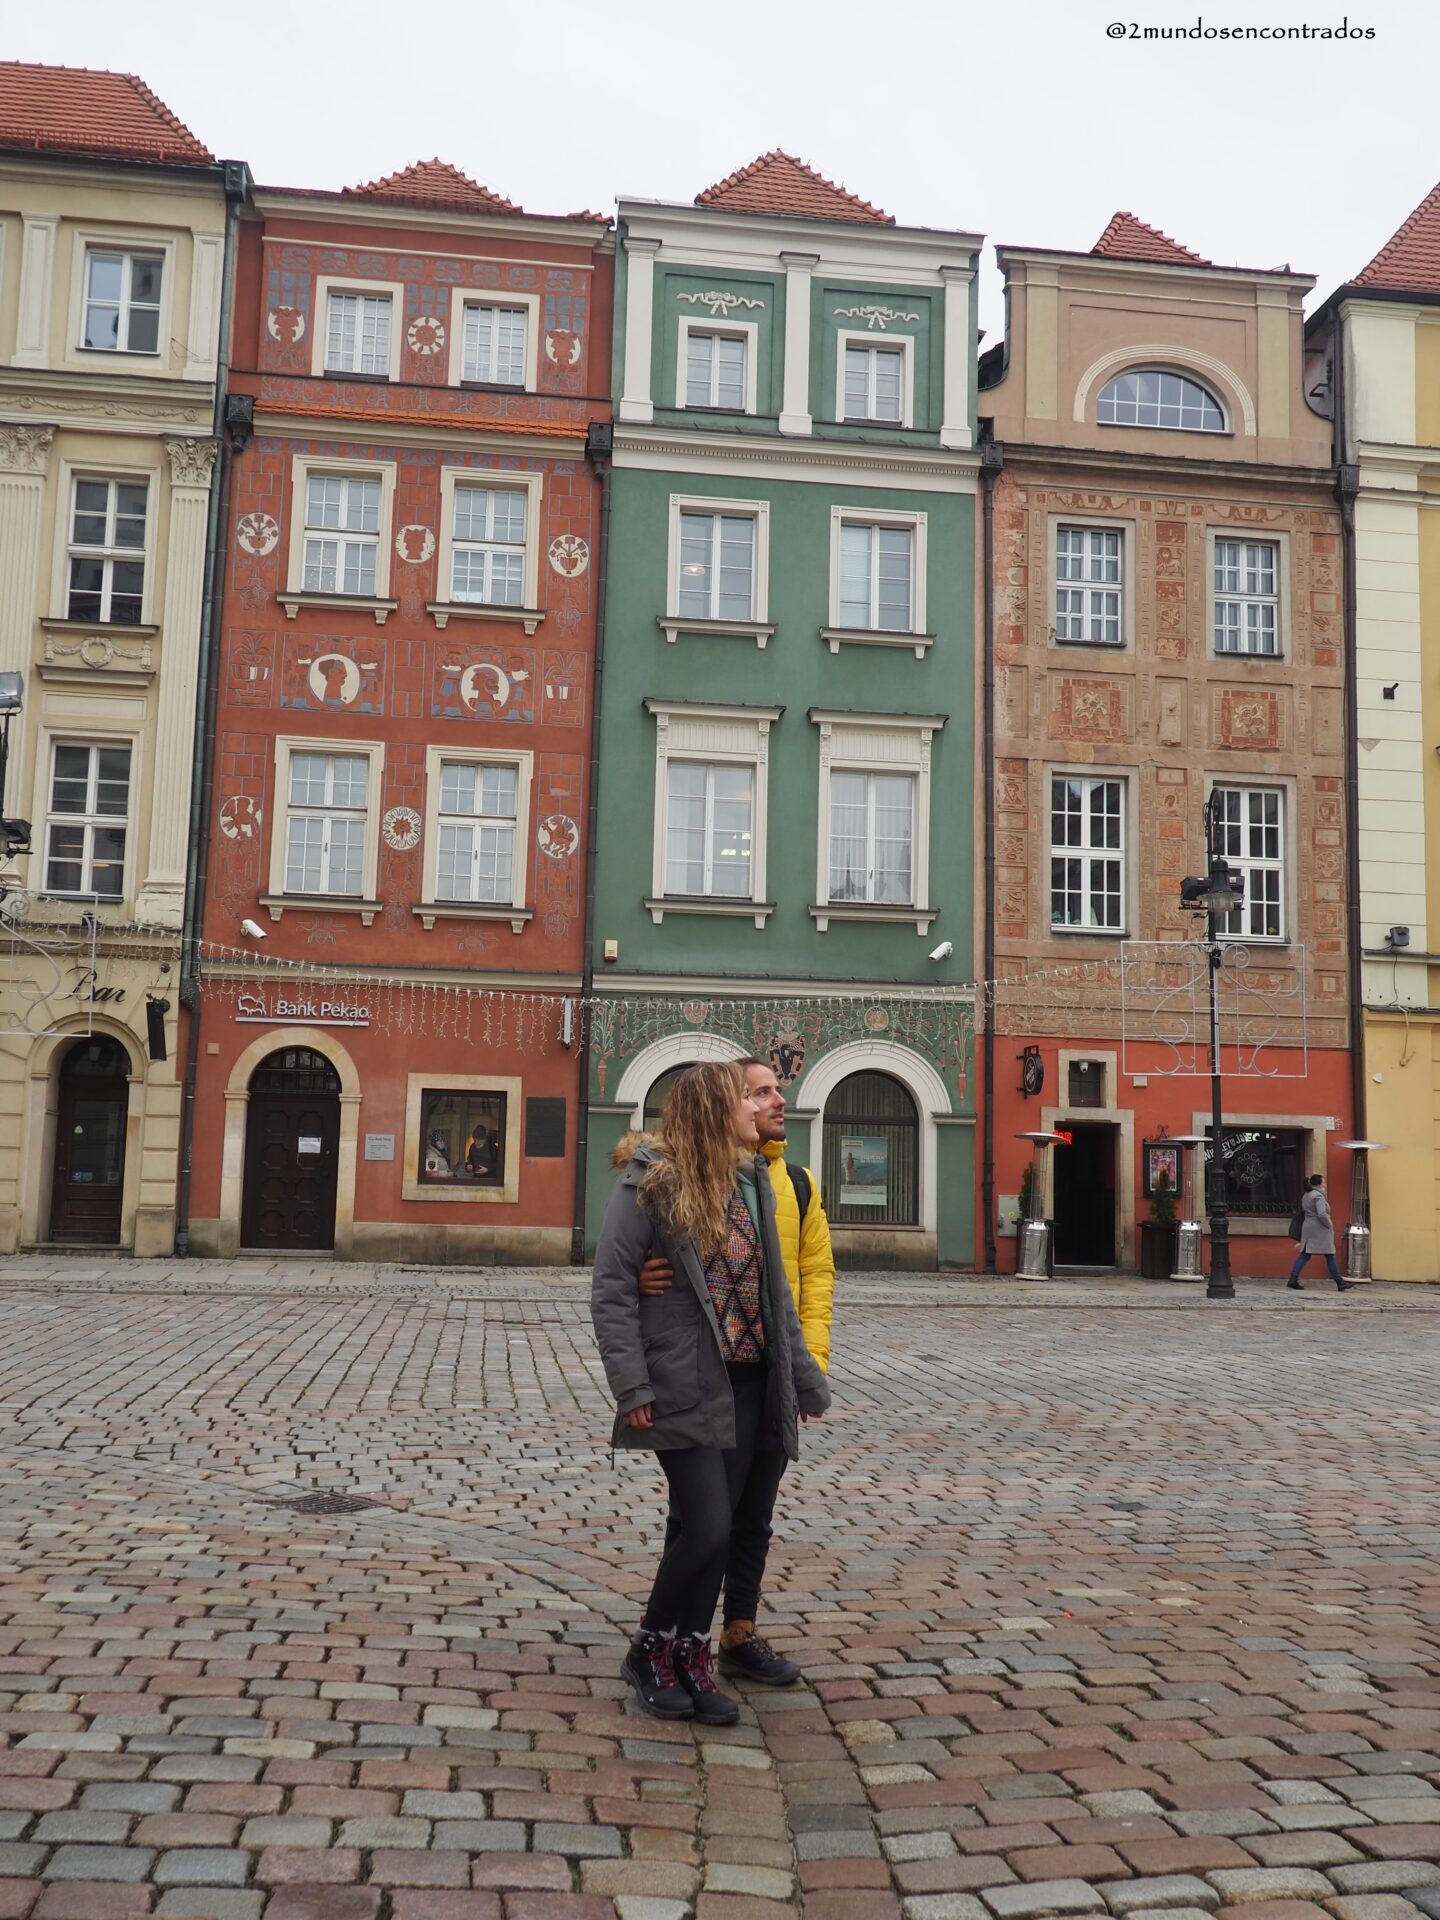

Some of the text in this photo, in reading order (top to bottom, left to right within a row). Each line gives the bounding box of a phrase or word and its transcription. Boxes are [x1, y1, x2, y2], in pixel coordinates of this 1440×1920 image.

[57, 966, 126, 1002] Bar
[276, 1000, 369, 1018] Bank Pekao
[1238, 1152, 1263, 1166] ROCK
[1240, 1172, 1263, 1184] ROLL
